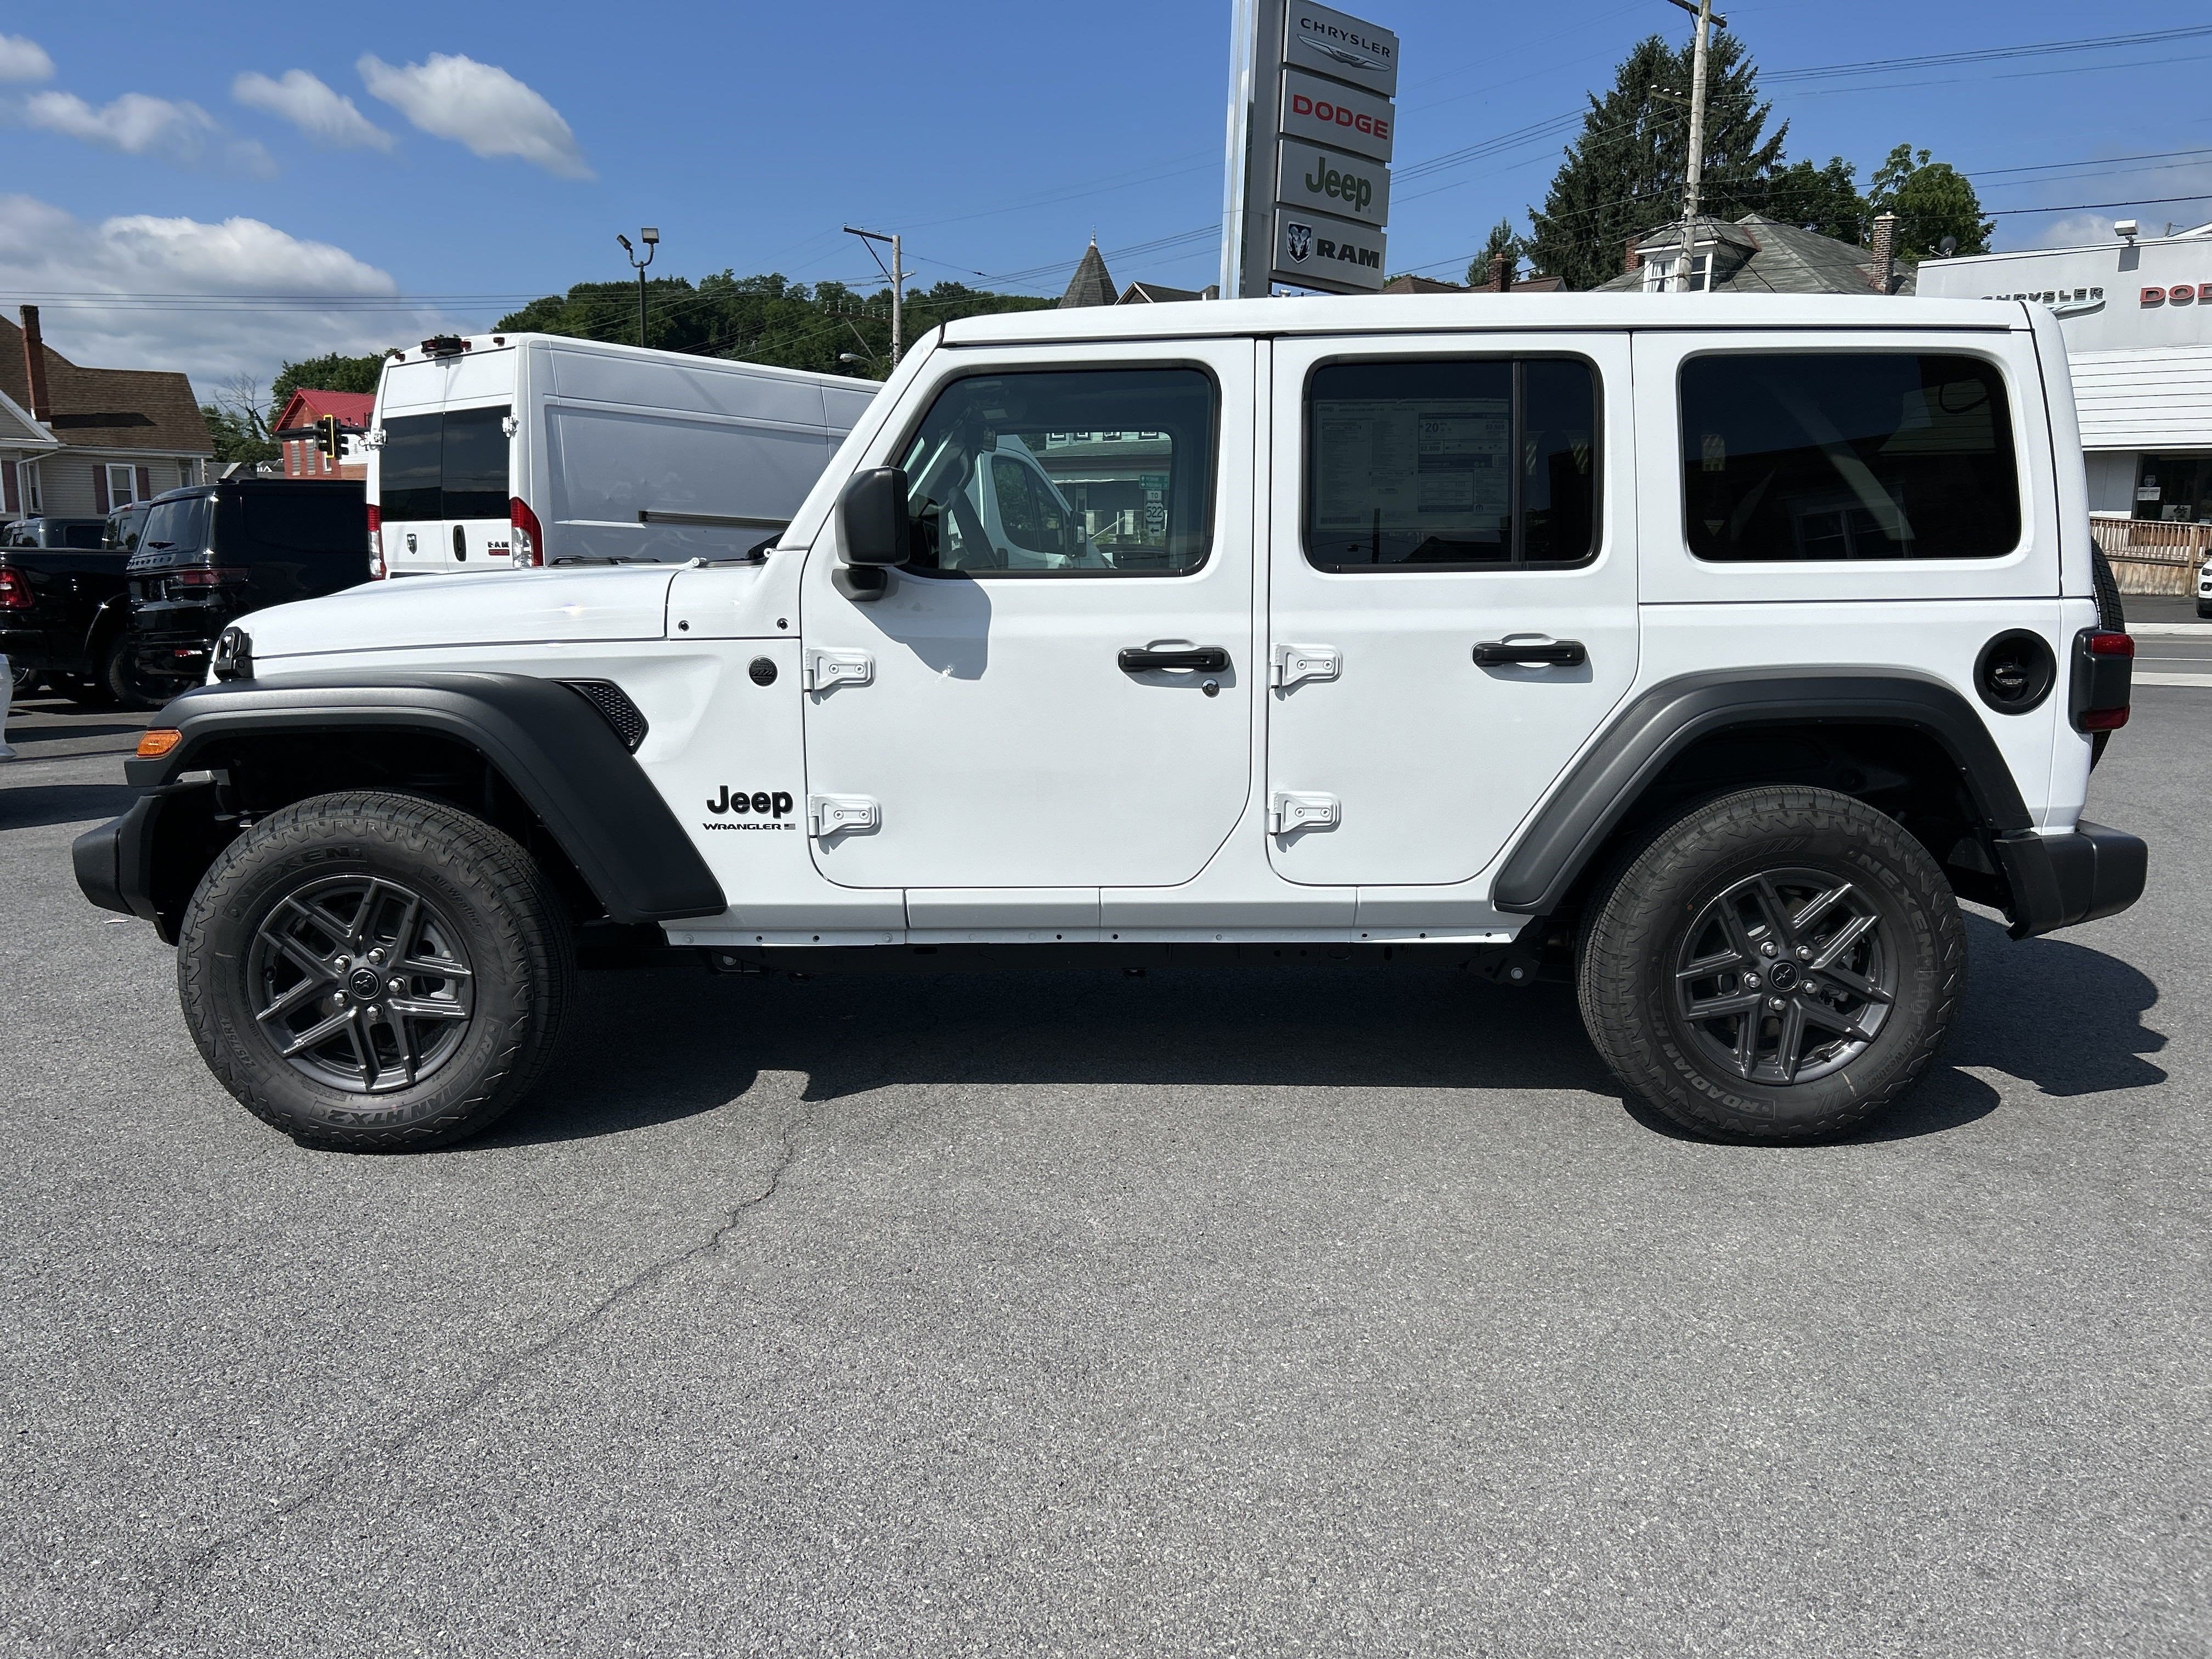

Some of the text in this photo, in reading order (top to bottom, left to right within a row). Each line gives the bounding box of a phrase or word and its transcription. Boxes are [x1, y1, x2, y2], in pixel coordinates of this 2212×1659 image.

[1300, 17, 1391, 58] CHRYSLER
[1293, 94, 1389, 140] DODGE
[1305, 156, 1372, 212] Jeep
[1316, 238, 1380, 269] RAM
[1147, 506, 1162, 518] 522
[706, 785, 793, 819] Jeep
[1856, 853, 1934, 956] NEXEN
[1661, 1042, 1760, 1113] ROADIAN
